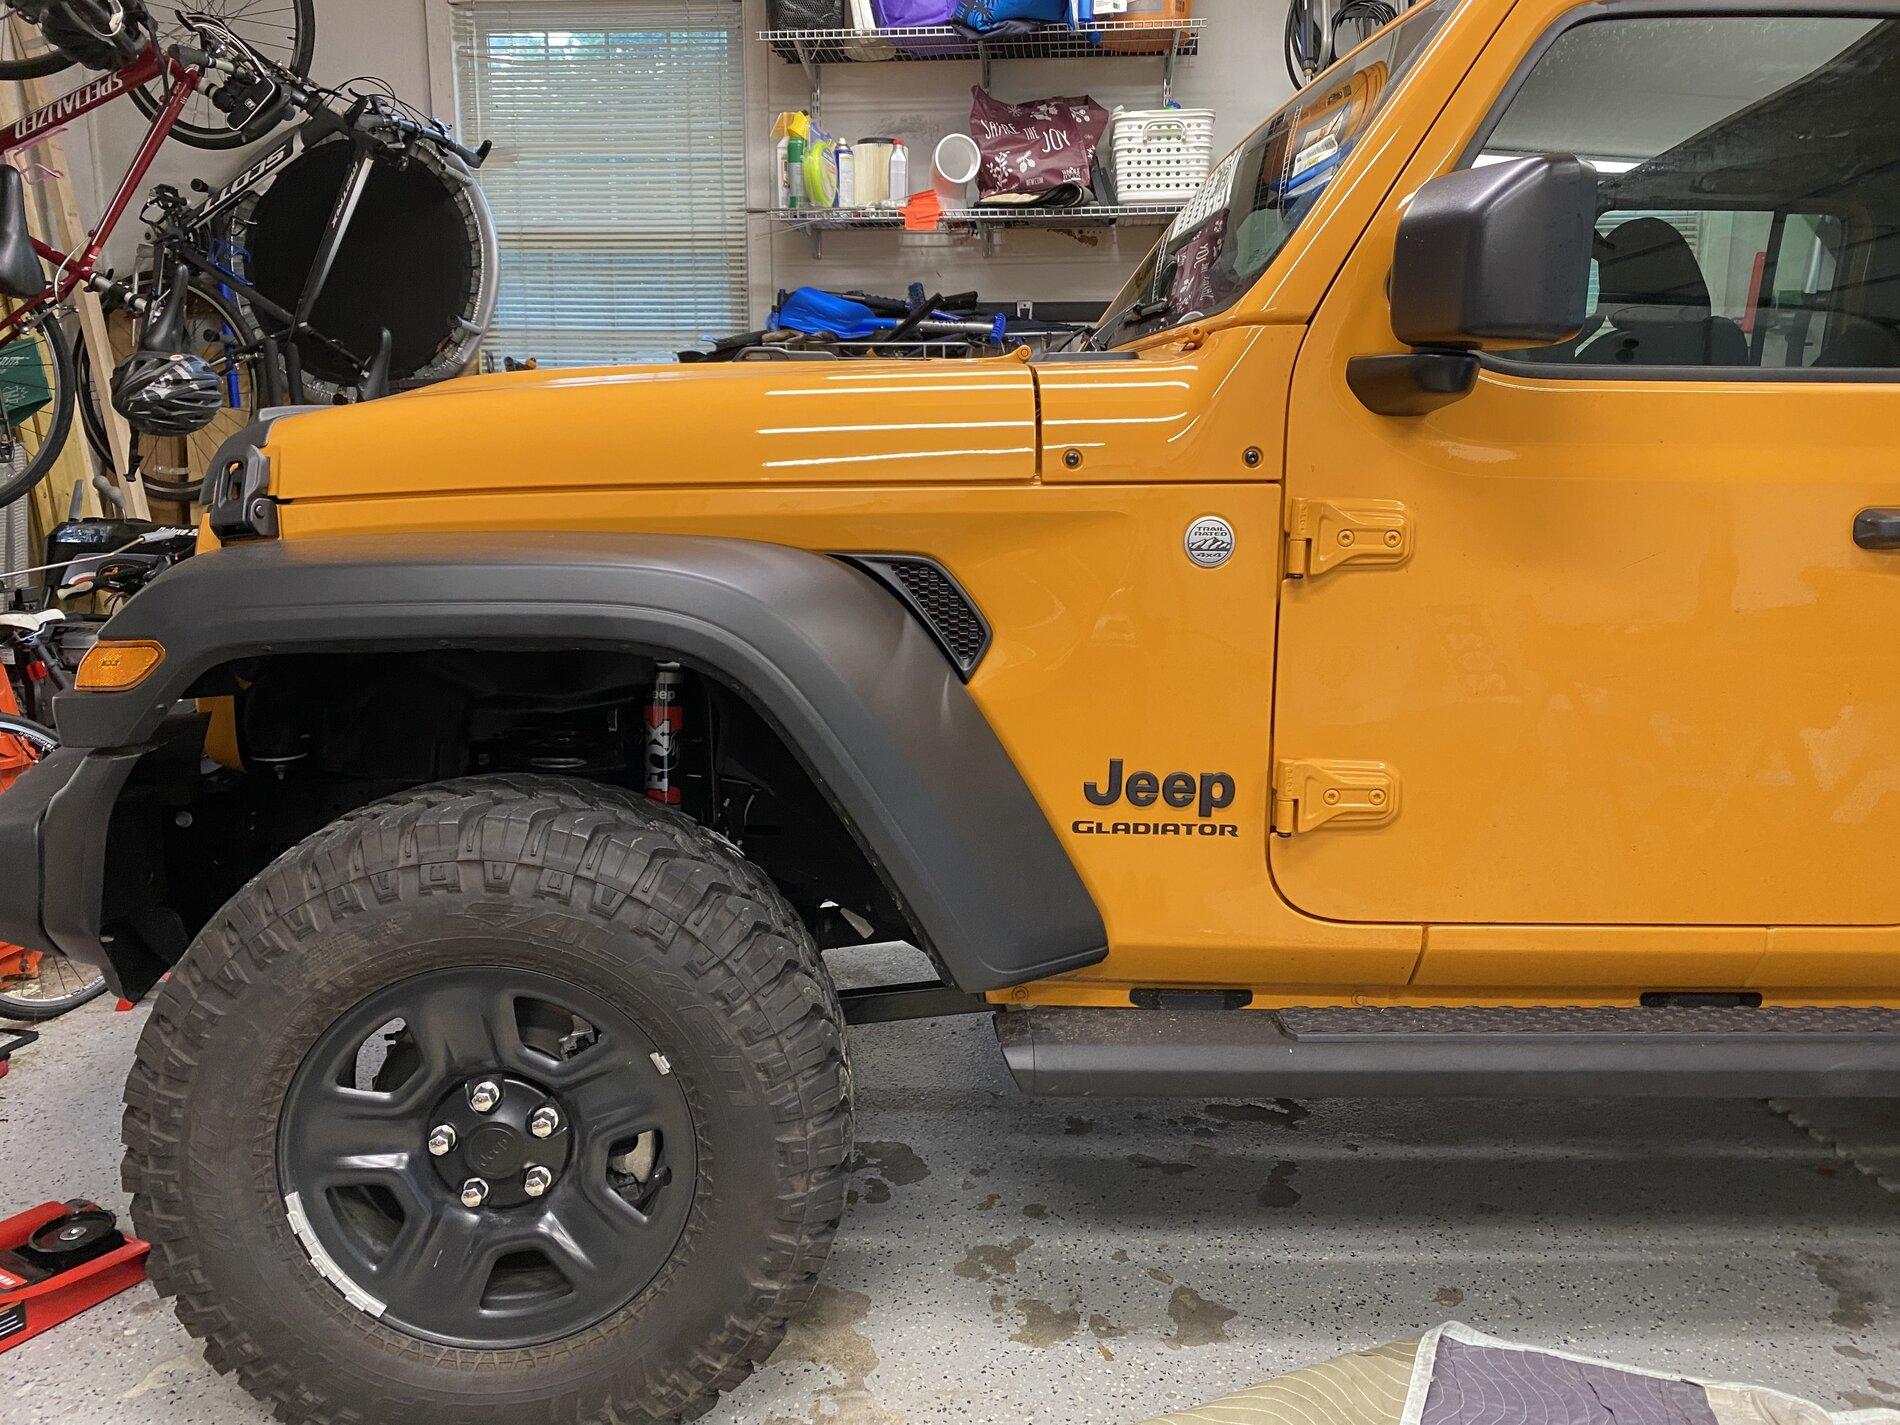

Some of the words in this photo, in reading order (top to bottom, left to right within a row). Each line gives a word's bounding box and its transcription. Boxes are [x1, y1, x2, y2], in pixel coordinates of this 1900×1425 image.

[15, 72, 123, 139] SPECIALIZED
[980, 119, 1020, 139] SHARE
[1023, 126, 1040, 140] THE
[1042, 129, 1071, 153] JOY
[198, 144, 287, 217] SCOTT
[652, 689, 676, 702] eep
[645, 719, 681, 793] FOX
[1083, 758, 1236, 817] Jeep
[1072, 820, 1239, 837] GLADIATOR
